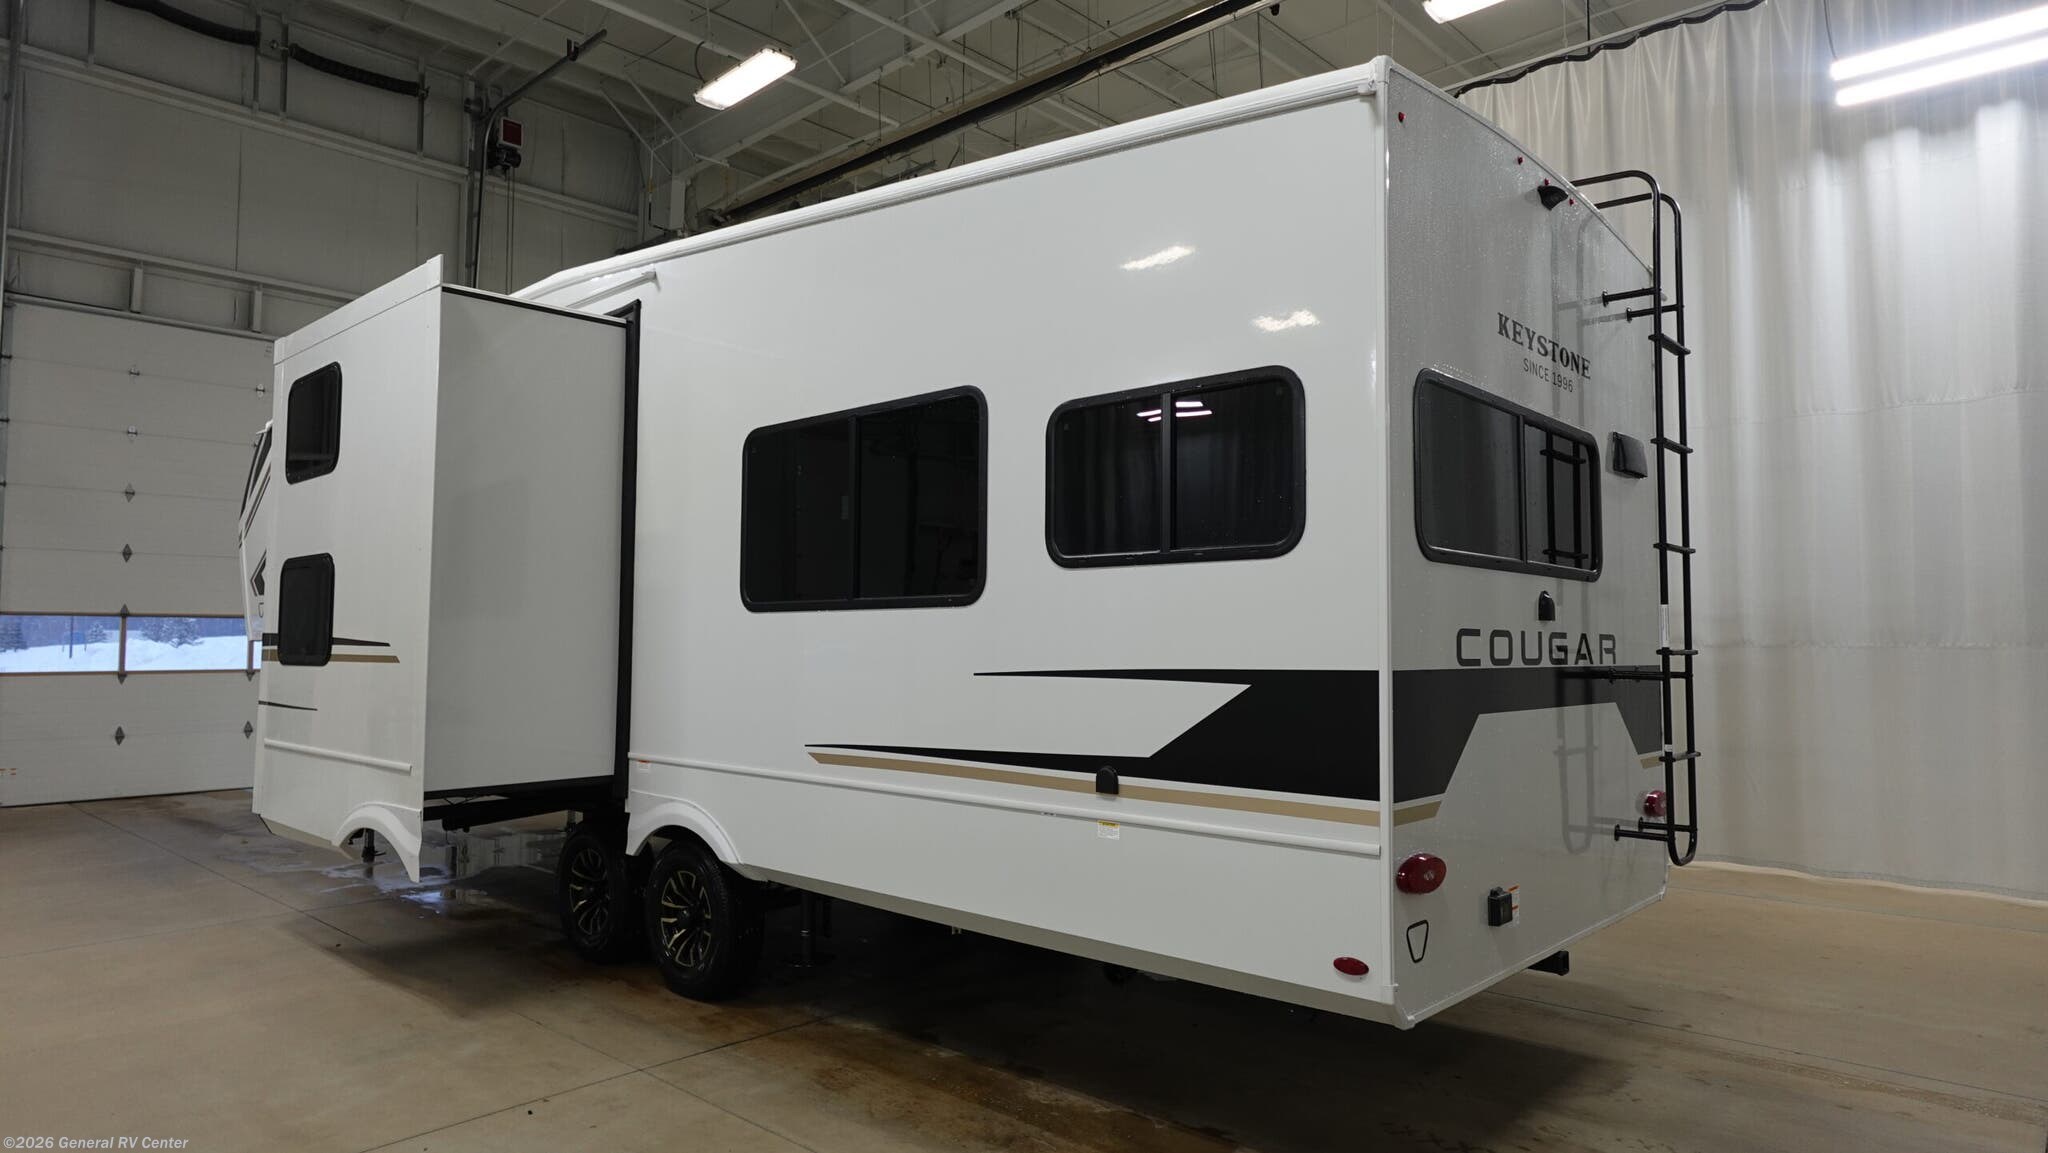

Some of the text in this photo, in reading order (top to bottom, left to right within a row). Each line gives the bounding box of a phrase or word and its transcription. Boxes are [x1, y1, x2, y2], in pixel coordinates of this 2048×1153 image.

[1497, 312, 1591, 380] KEYSTONE
[1523, 358, 1574, 393] SINCE 1996
[1456, 628, 1617, 667] COUGAR
